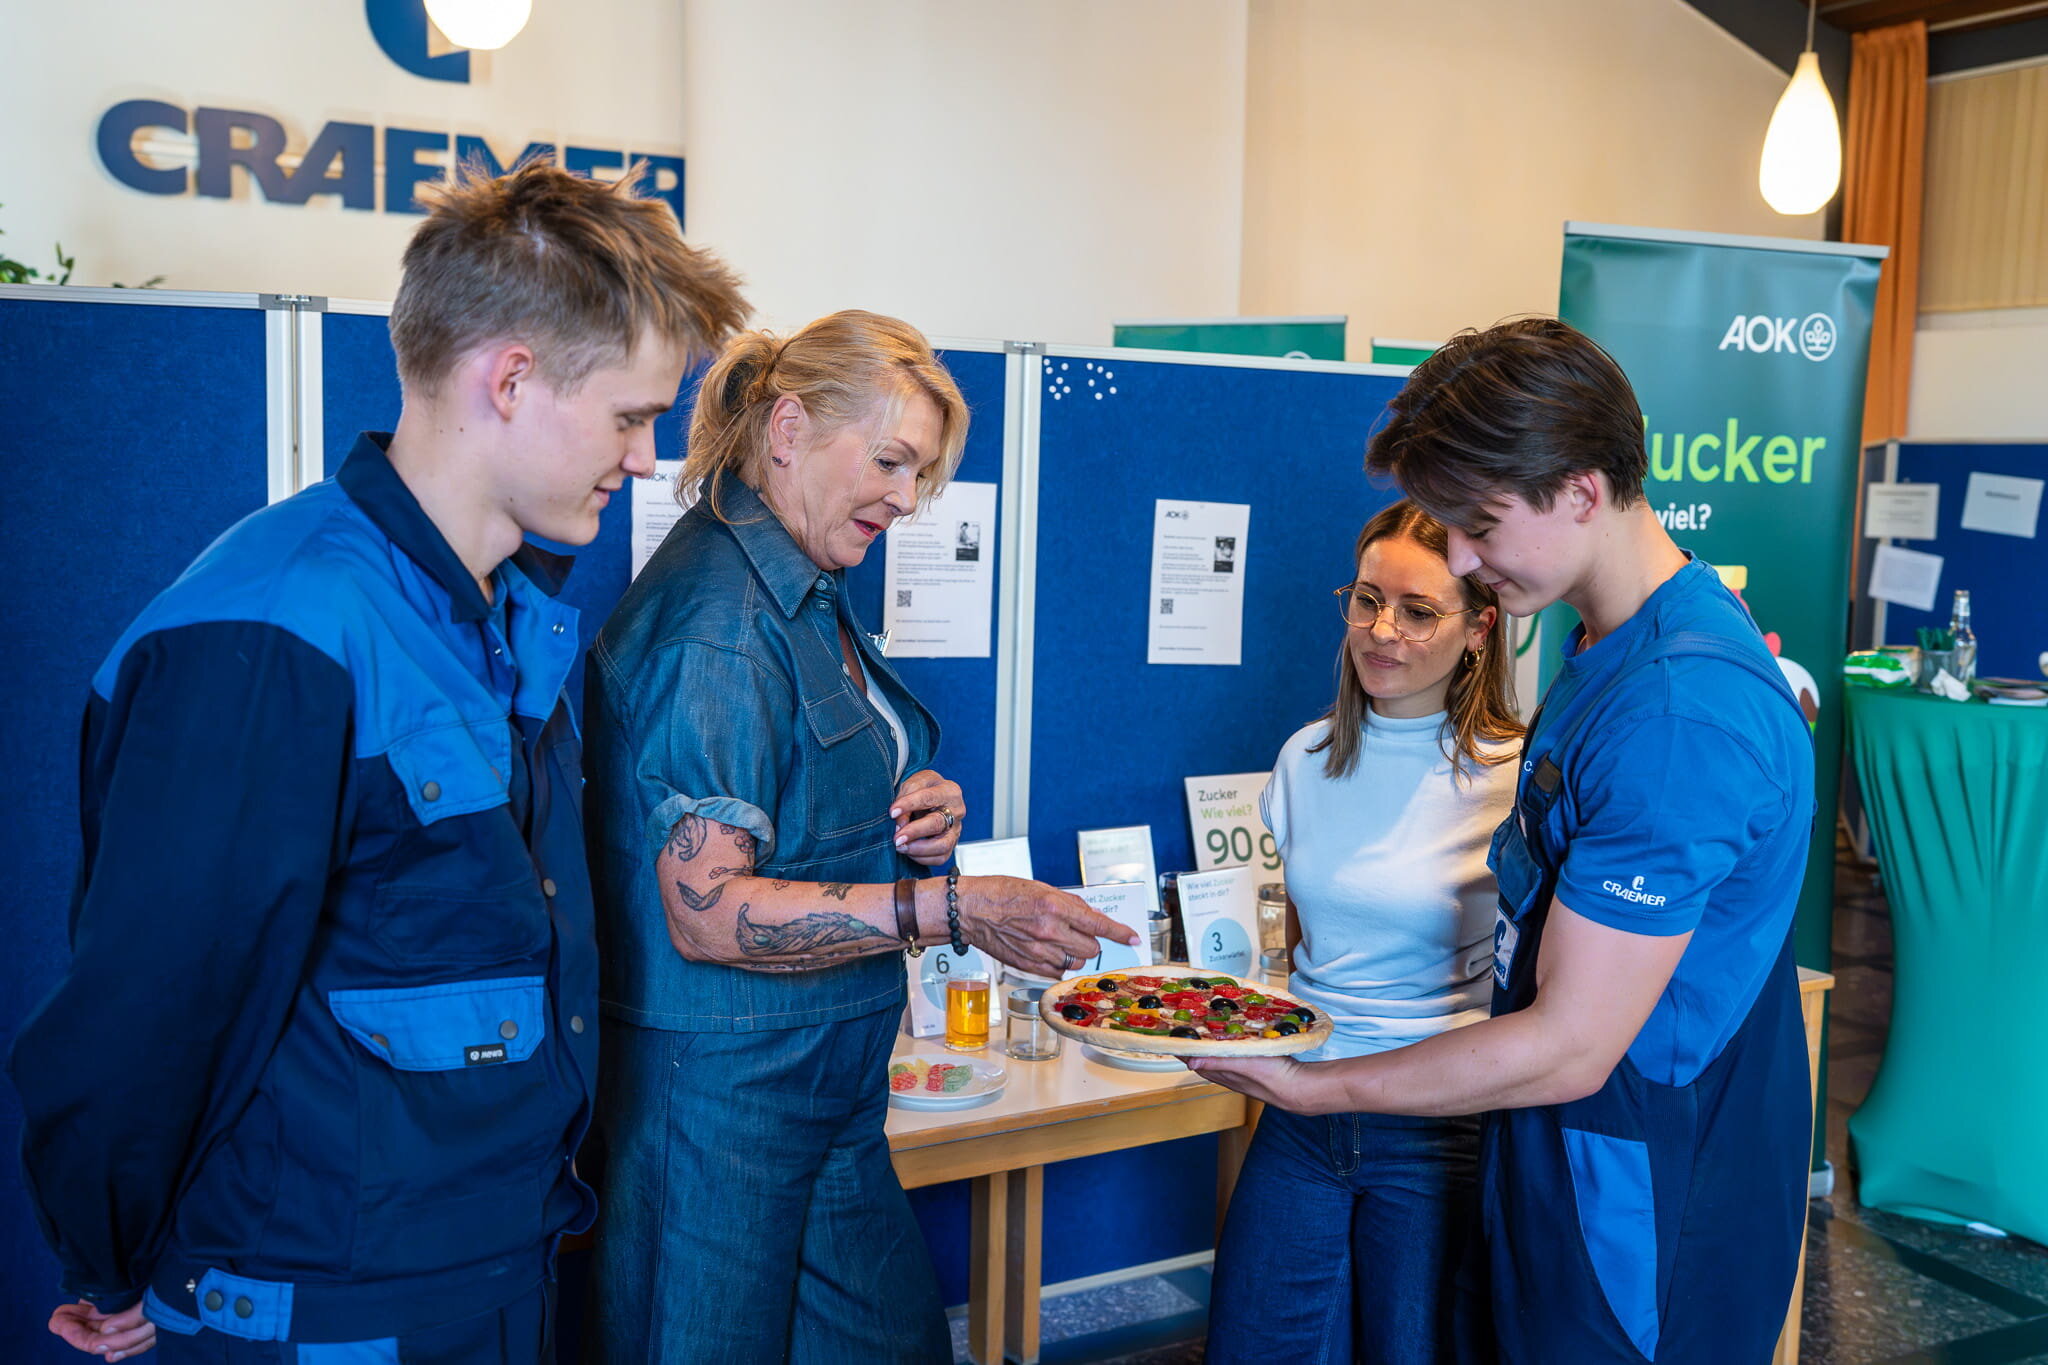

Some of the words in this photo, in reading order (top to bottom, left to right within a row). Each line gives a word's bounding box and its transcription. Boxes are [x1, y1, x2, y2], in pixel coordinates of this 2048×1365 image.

[97, 98, 685, 234] CRAER
[1718, 314, 1798, 354] AOK
[1642, 414, 1827, 484] ucker
[1654, 502, 1712, 531] viel?
[1198, 787, 1239, 802] Zucker
[1200, 807, 1224, 819] Wie
[1226, 804, 1253, 817] viel?
[1206, 826, 1253, 865] 90
[1099, 894, 1126, 902] Zucker
[1602, 880, 1667, 907] CRAEMER
[1212, 931, 1223, 952] 3
[935, 952, 950, 974] 6
